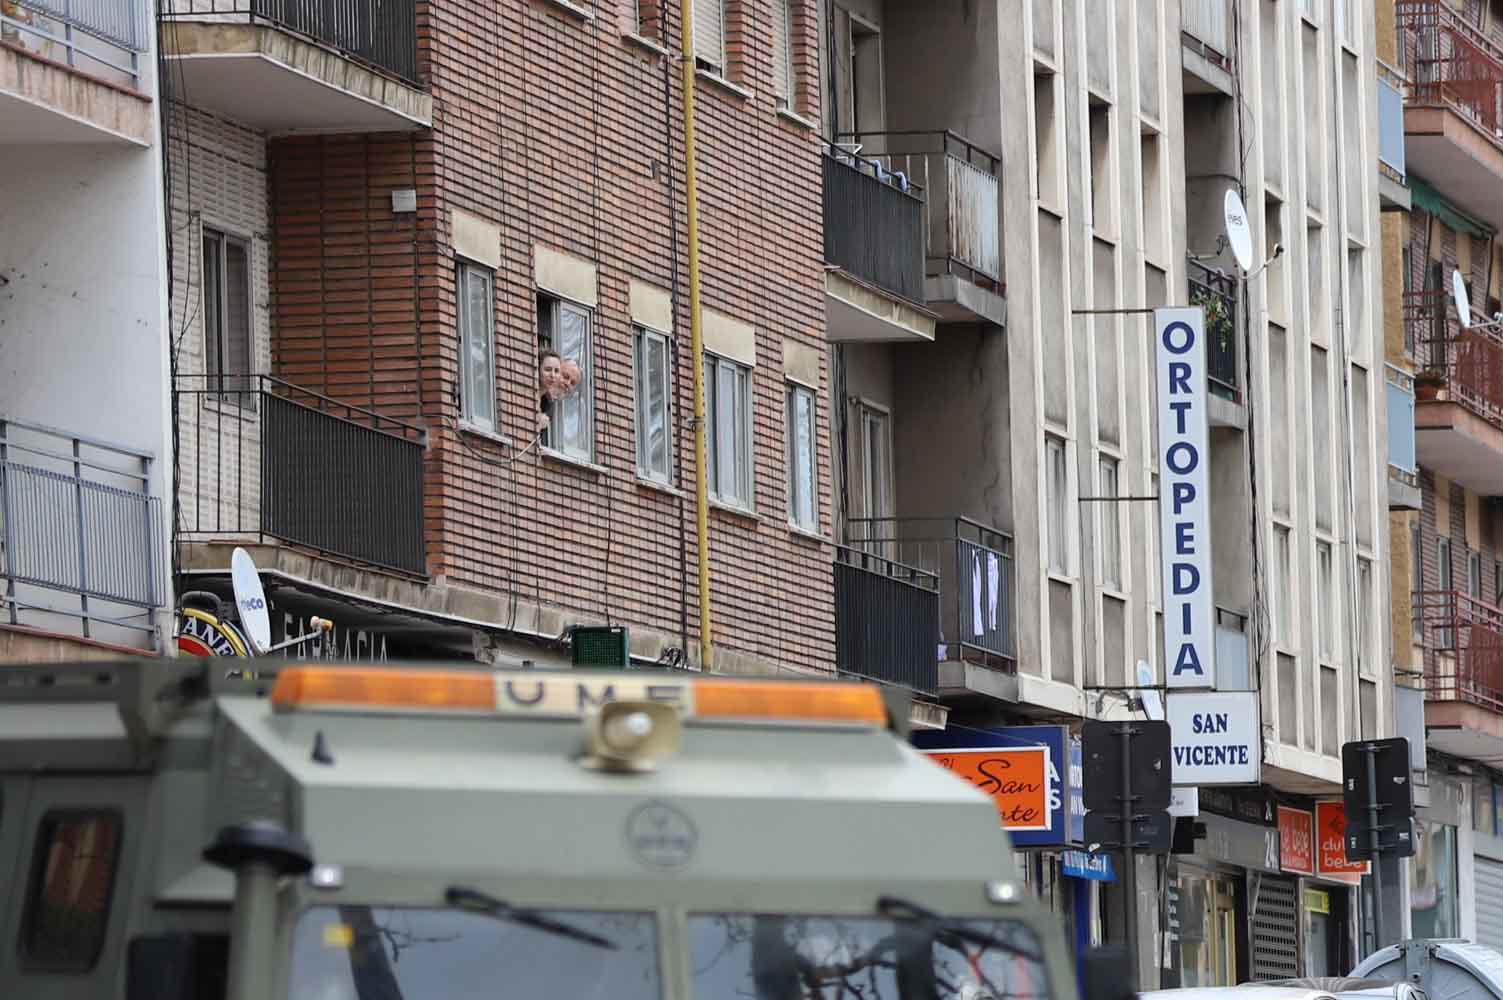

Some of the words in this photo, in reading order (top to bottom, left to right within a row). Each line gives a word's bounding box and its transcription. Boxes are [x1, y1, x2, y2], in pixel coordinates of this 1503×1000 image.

[1161, 320, 1204, 676] ORTOPEDIA
[1192, 713, 1228, 733] SAN
[1173, 745, 1249, 766] VICENTE
[977, 758, 1041, 794] San
